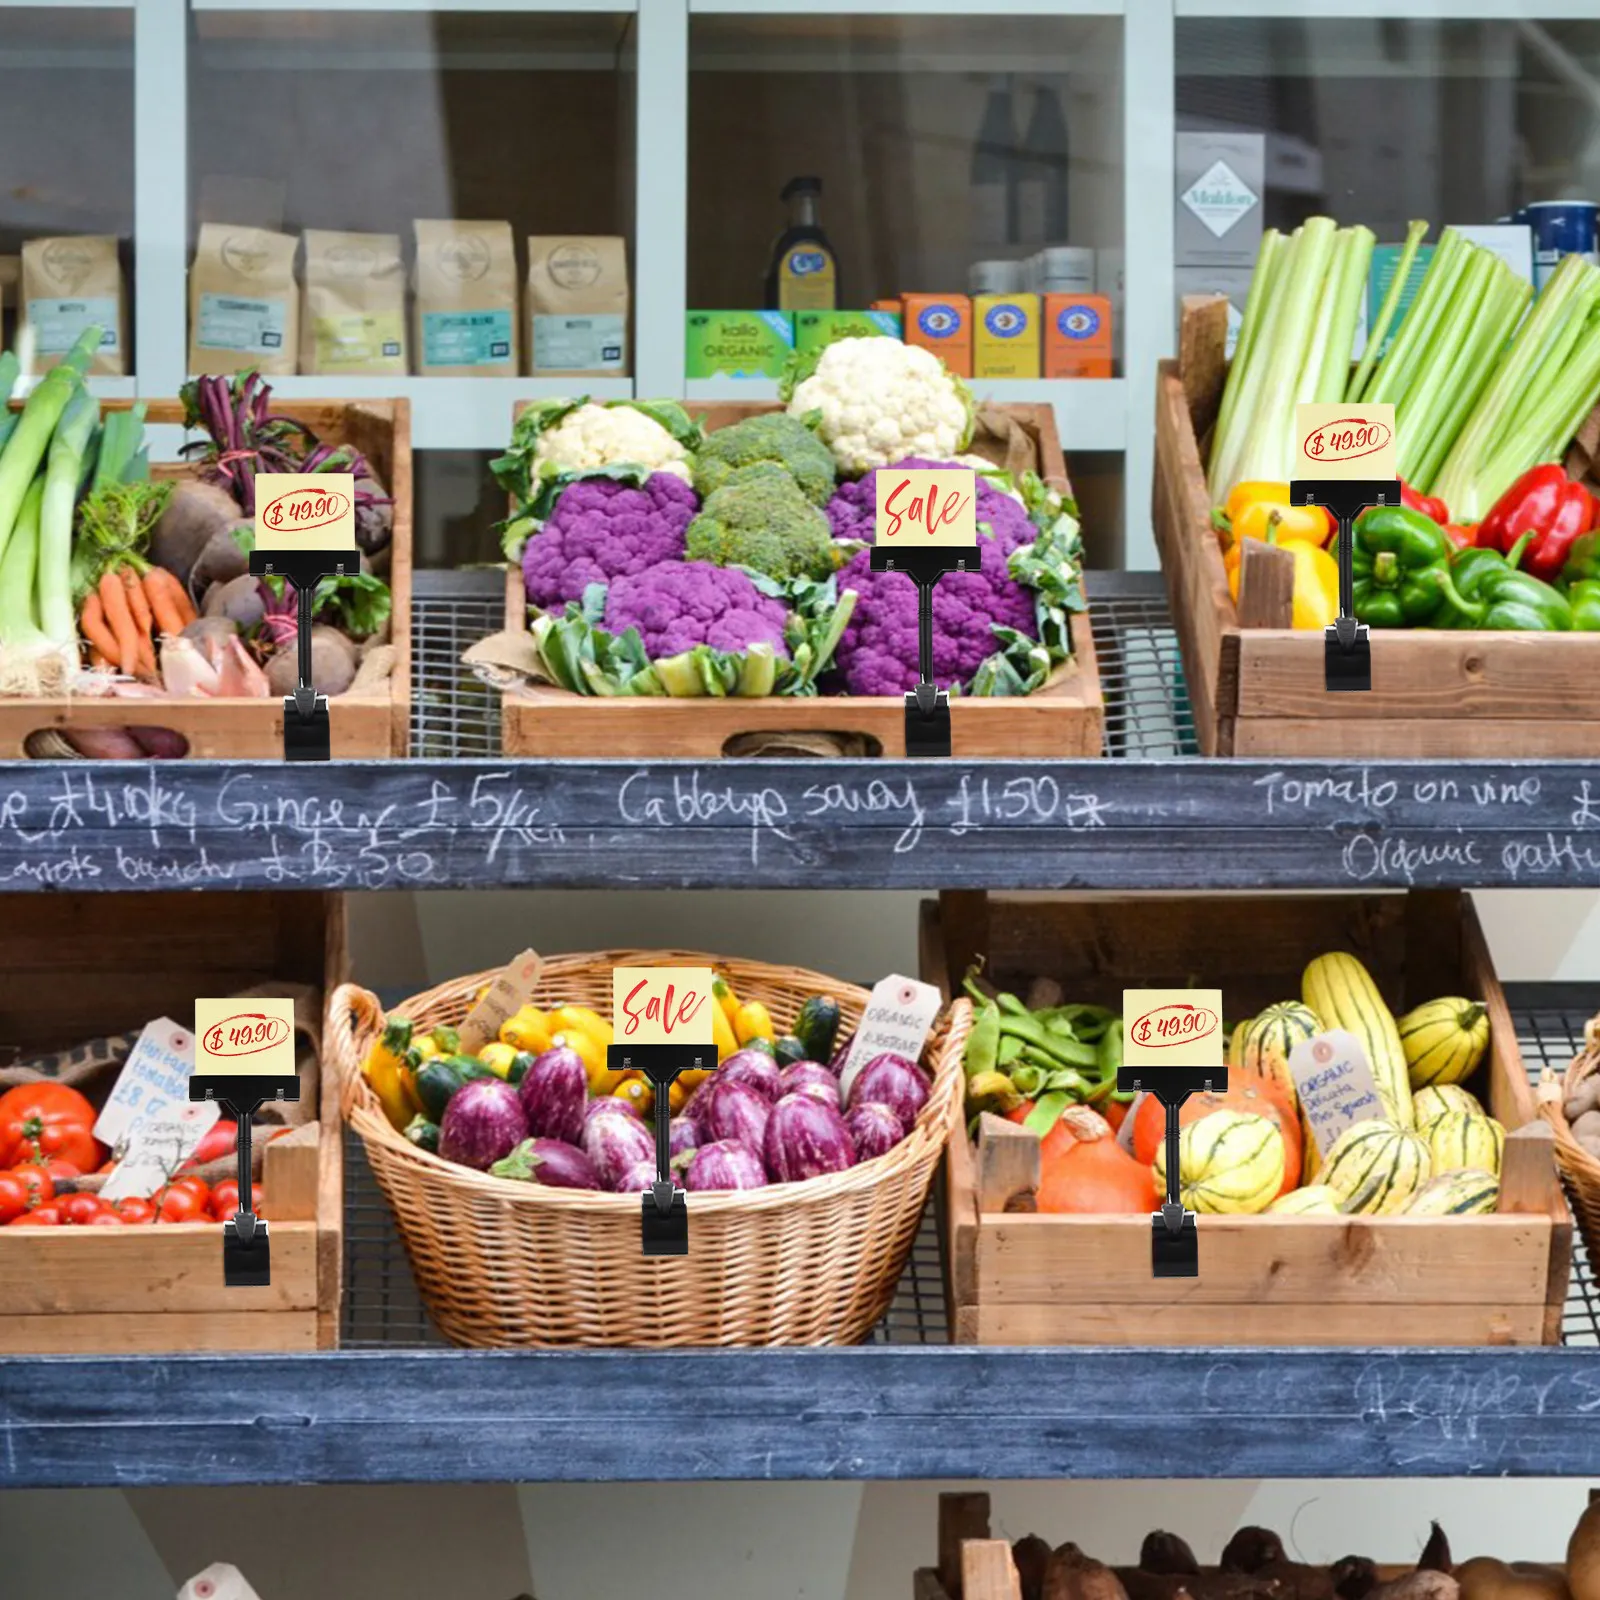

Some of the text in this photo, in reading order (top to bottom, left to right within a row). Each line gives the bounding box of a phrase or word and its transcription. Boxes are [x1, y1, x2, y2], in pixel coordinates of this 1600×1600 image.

[703, 344, 775, 357] ORGANIC
[1329, 425, 1380, 452] 49.90
[288, 495, 339, 522] 49.90
[884, 478, 971, 537] Sale
[946, 774, 1060, 835] £1.50
[1253, 768, 1398, 814] Tomato
[1414, 781, 1458, 803] on
[1470, 775, 1541, 806] vine
[622, 978, 707, 1036] Sale
[229, 1020, 279, 1046] 49.90
[1156, 1010, 1207, 1037] 49.90
